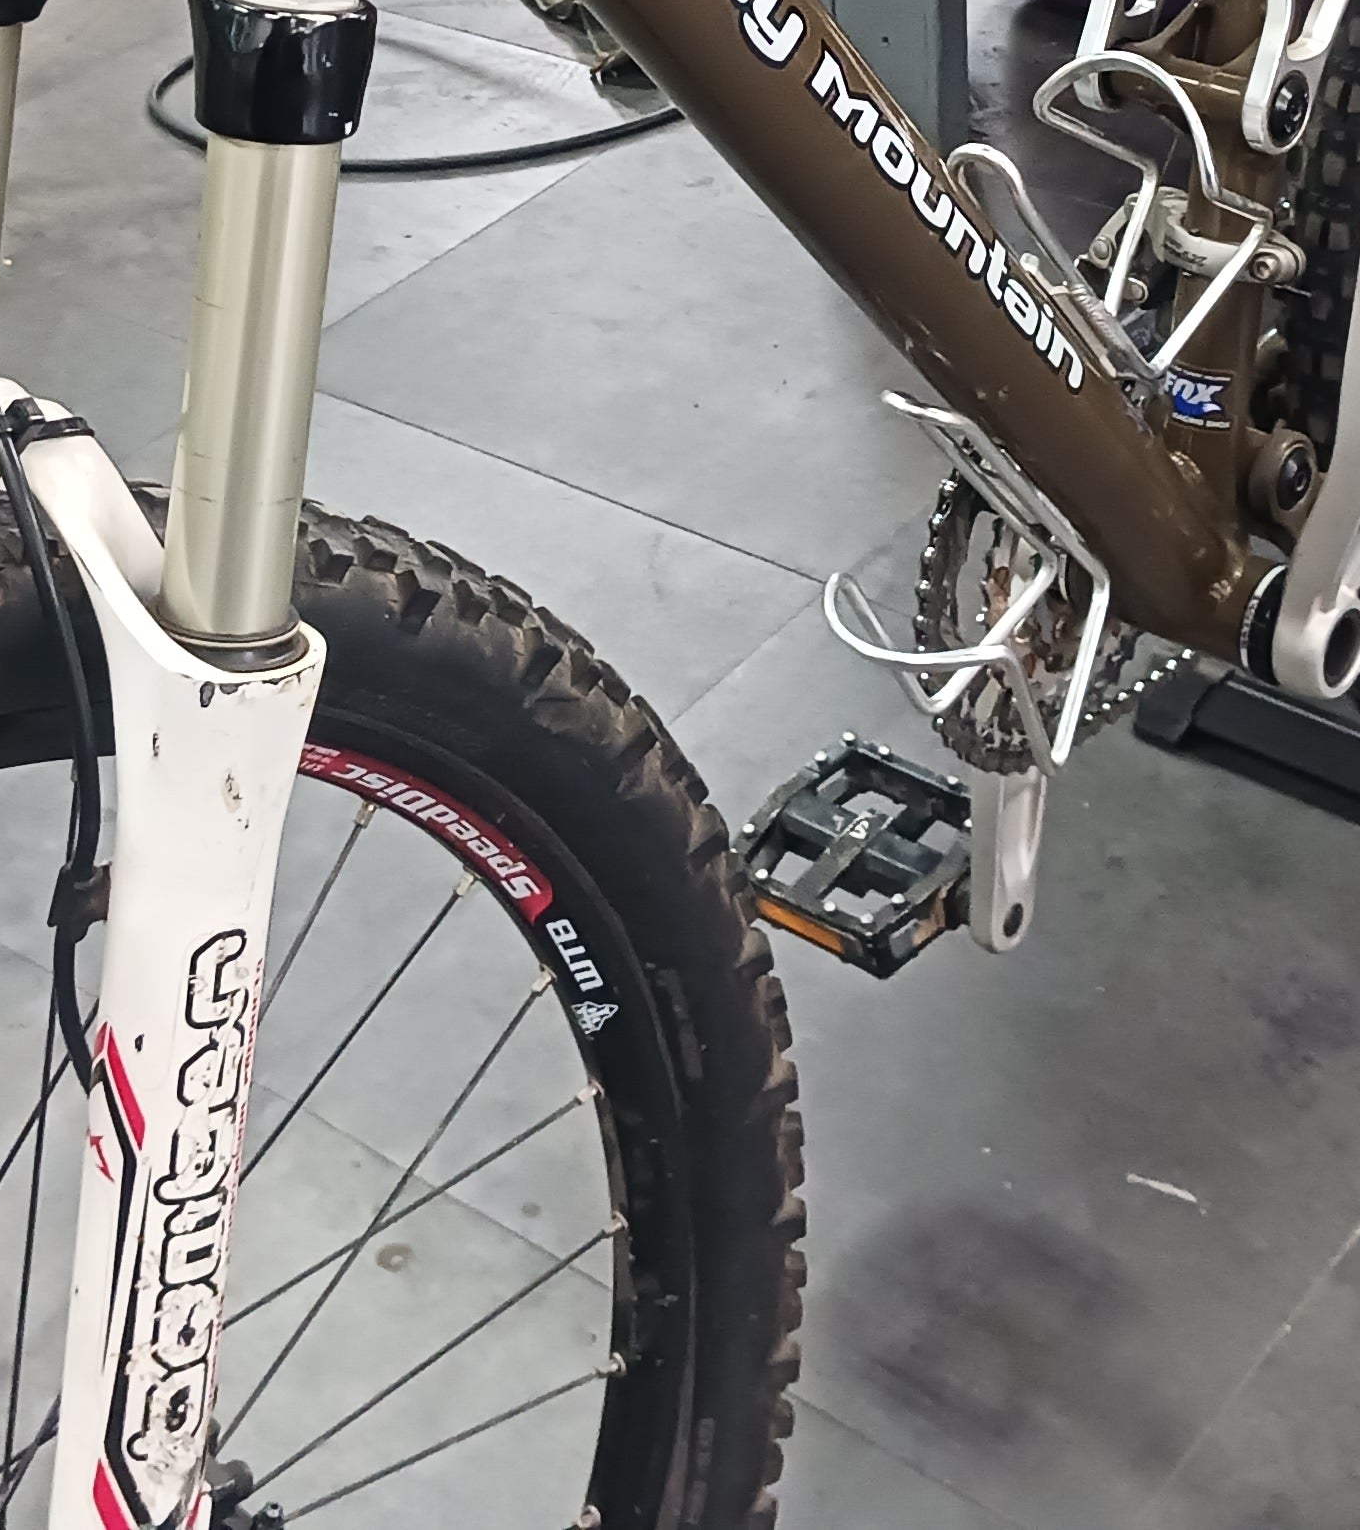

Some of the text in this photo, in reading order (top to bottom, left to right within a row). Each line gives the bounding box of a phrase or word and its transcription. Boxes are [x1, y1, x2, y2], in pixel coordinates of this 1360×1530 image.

[1163, 370, 1224, 405] FOX
[330, 761, 542, 903] SpeedDisc
[544, 918, 605, 993] WTB
